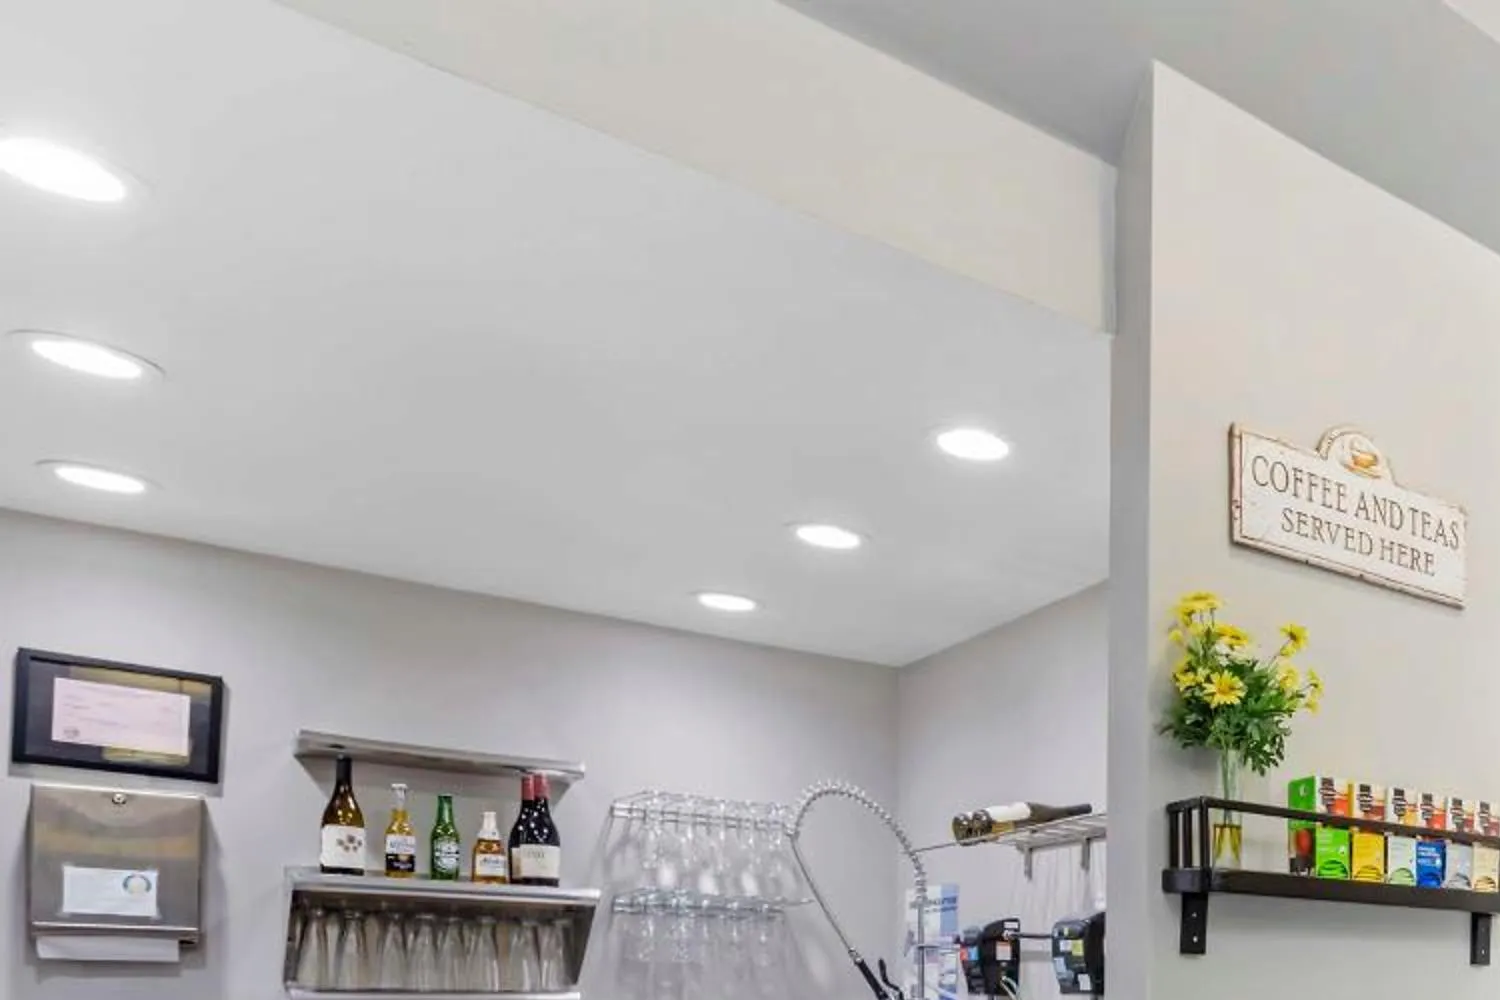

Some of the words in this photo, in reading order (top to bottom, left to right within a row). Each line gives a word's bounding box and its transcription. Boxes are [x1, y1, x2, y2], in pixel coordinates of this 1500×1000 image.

[1251, 455, 1348, 513] COFFEE
[1354, 491, 1403, 531] AND
[1408, 506, 1460, 550] TEAS
[1280, 507, 1374, 557] SERVED
[1380, 537, 1436, 576] HERE
